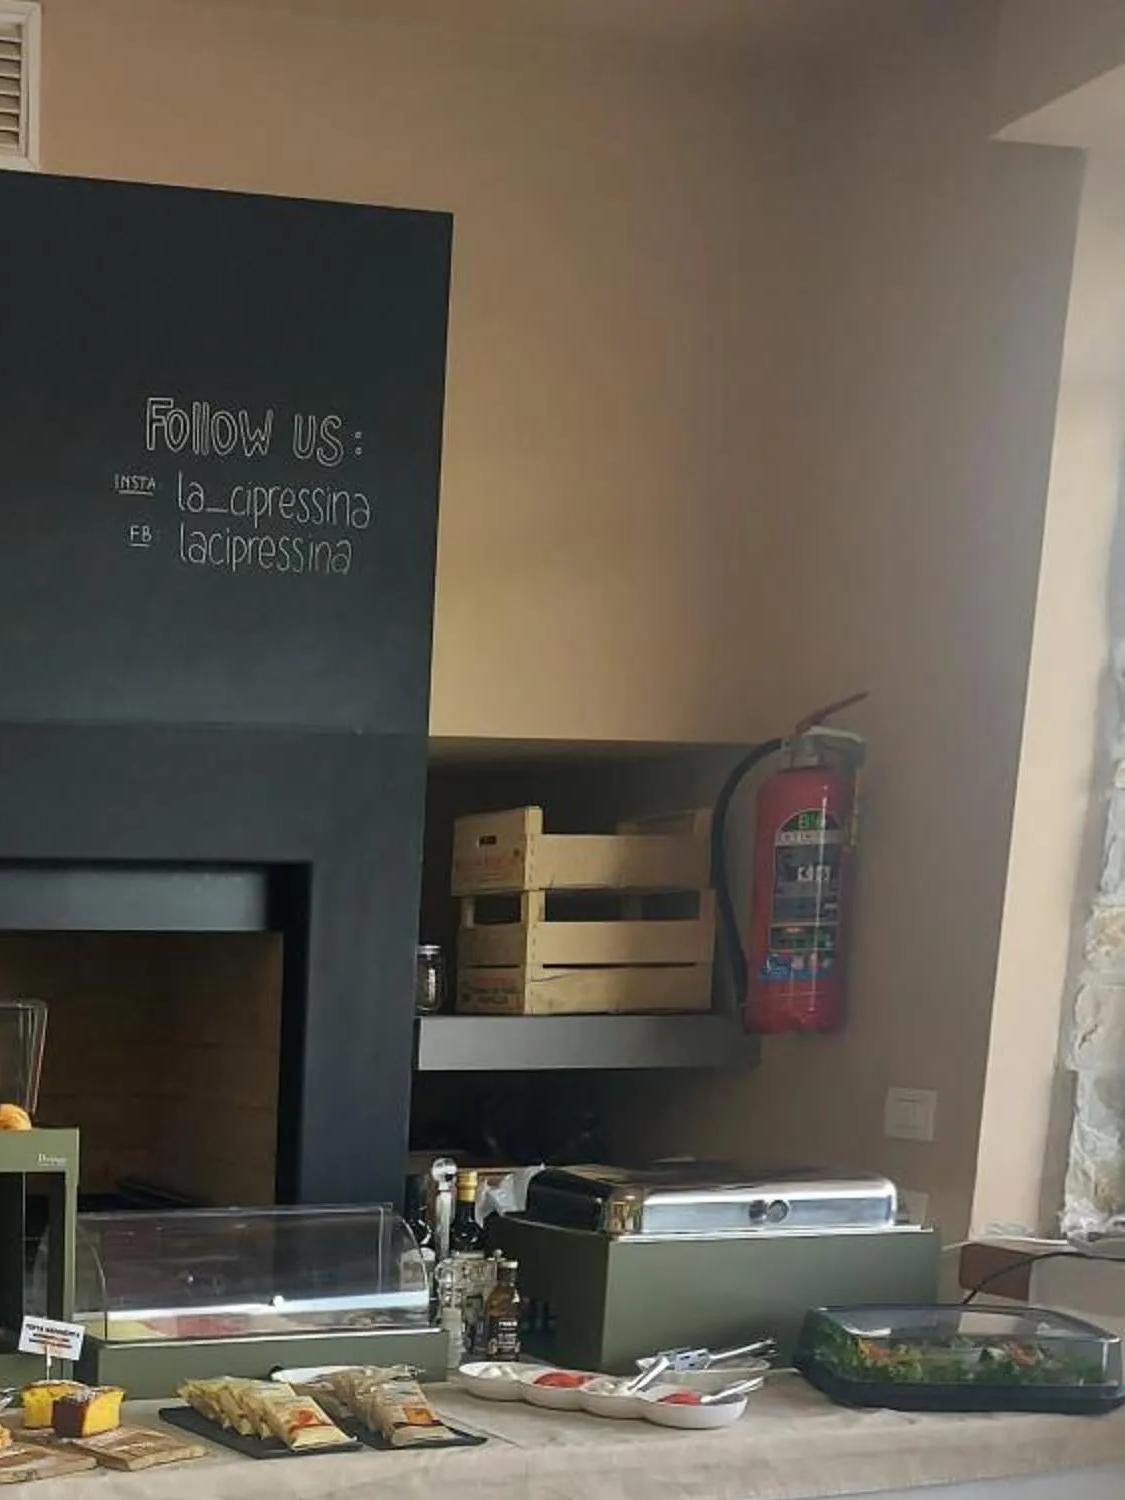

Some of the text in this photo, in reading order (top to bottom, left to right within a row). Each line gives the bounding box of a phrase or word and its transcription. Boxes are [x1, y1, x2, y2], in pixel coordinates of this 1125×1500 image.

[146, 396, 274, 458] Follow
[113, 470, 372, 530] INSTA la_cipressina
[129, 521, 353, 575] FB lacipressina
